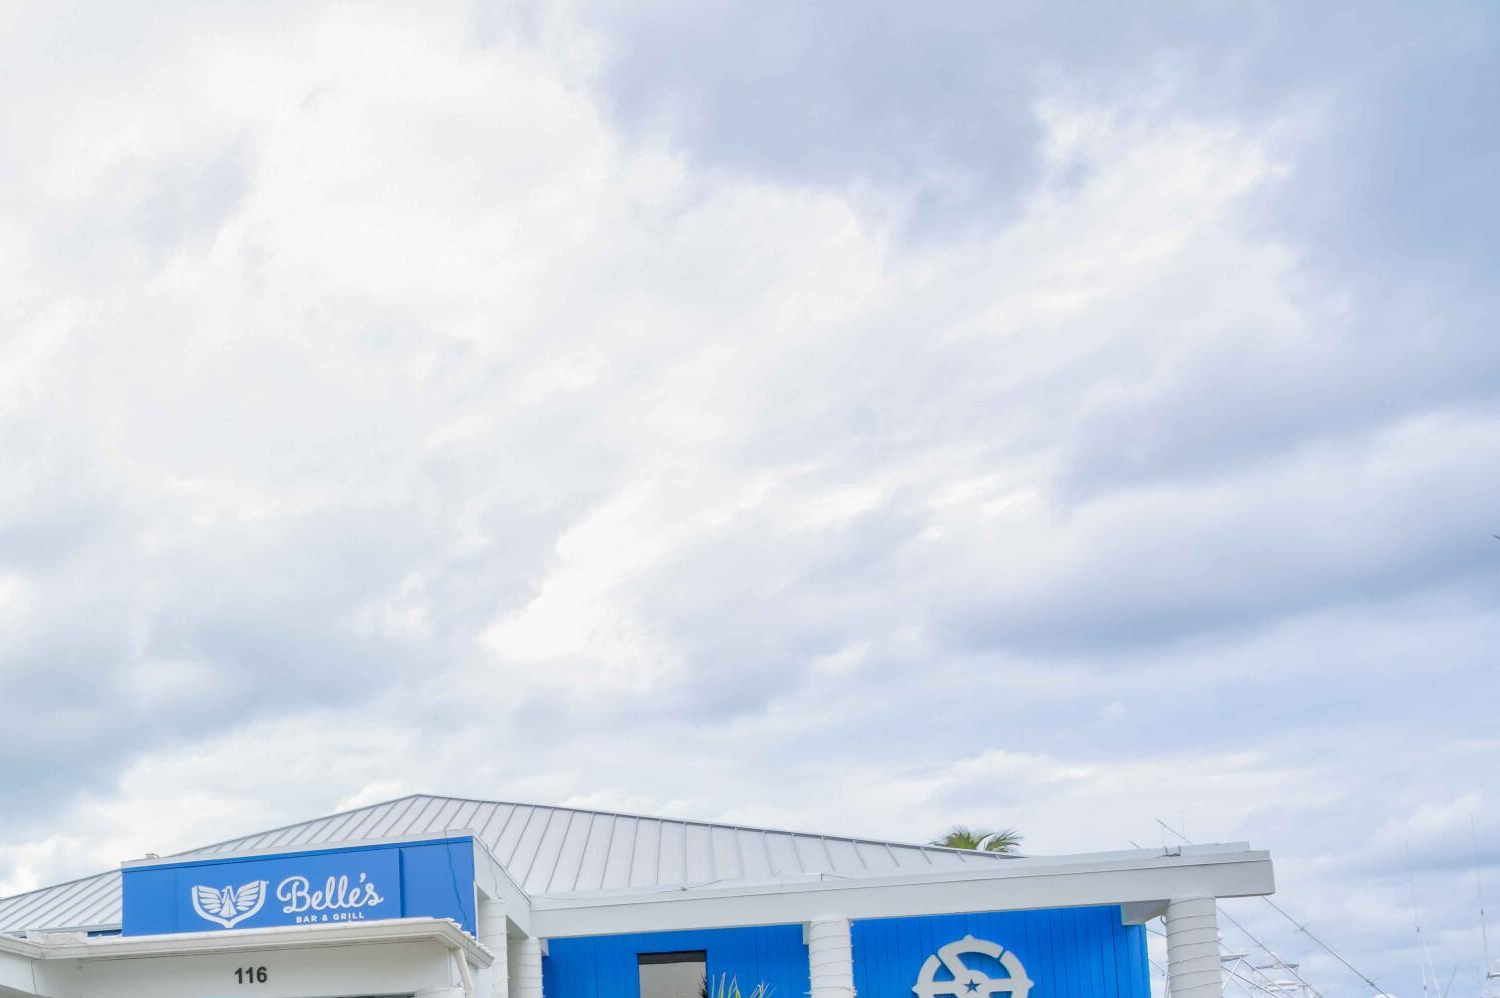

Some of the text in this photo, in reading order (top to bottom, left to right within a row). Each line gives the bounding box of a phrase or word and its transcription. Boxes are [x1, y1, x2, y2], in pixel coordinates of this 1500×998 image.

[276, 872, 384, 914] Belle's
[296, 912, 365, 924] BAR & GRILL
[234, 966, 268, 985] 116
